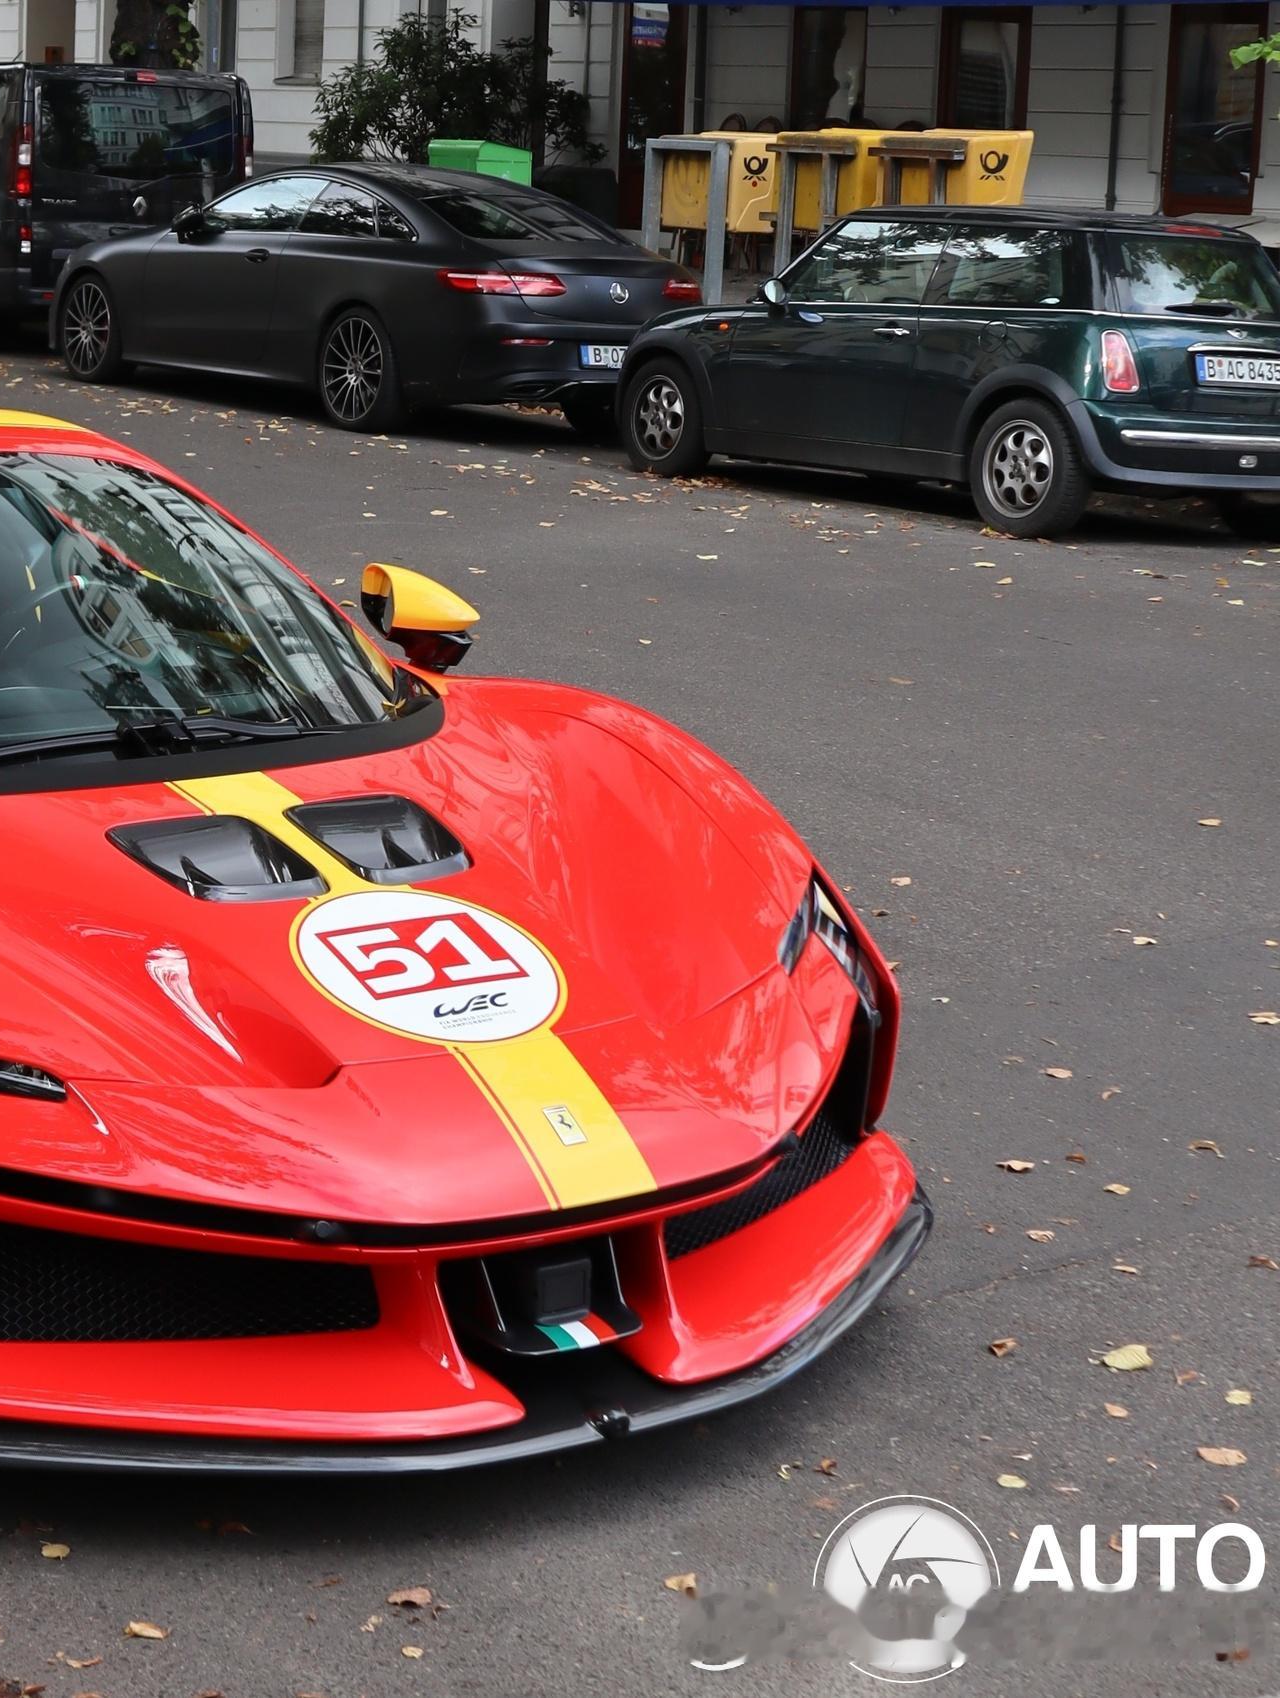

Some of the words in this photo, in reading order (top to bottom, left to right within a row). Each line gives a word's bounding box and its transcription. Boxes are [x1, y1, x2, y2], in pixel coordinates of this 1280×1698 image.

[593, 347, 602, 363] B
[1207, 359, 1217, 378] B
[1227, 360, 1245, 379] AC
[1248, 361, 1280, 381] 8435
[325, 919, 521, 995] 51
[433, 992, 509, 1018] WEC
